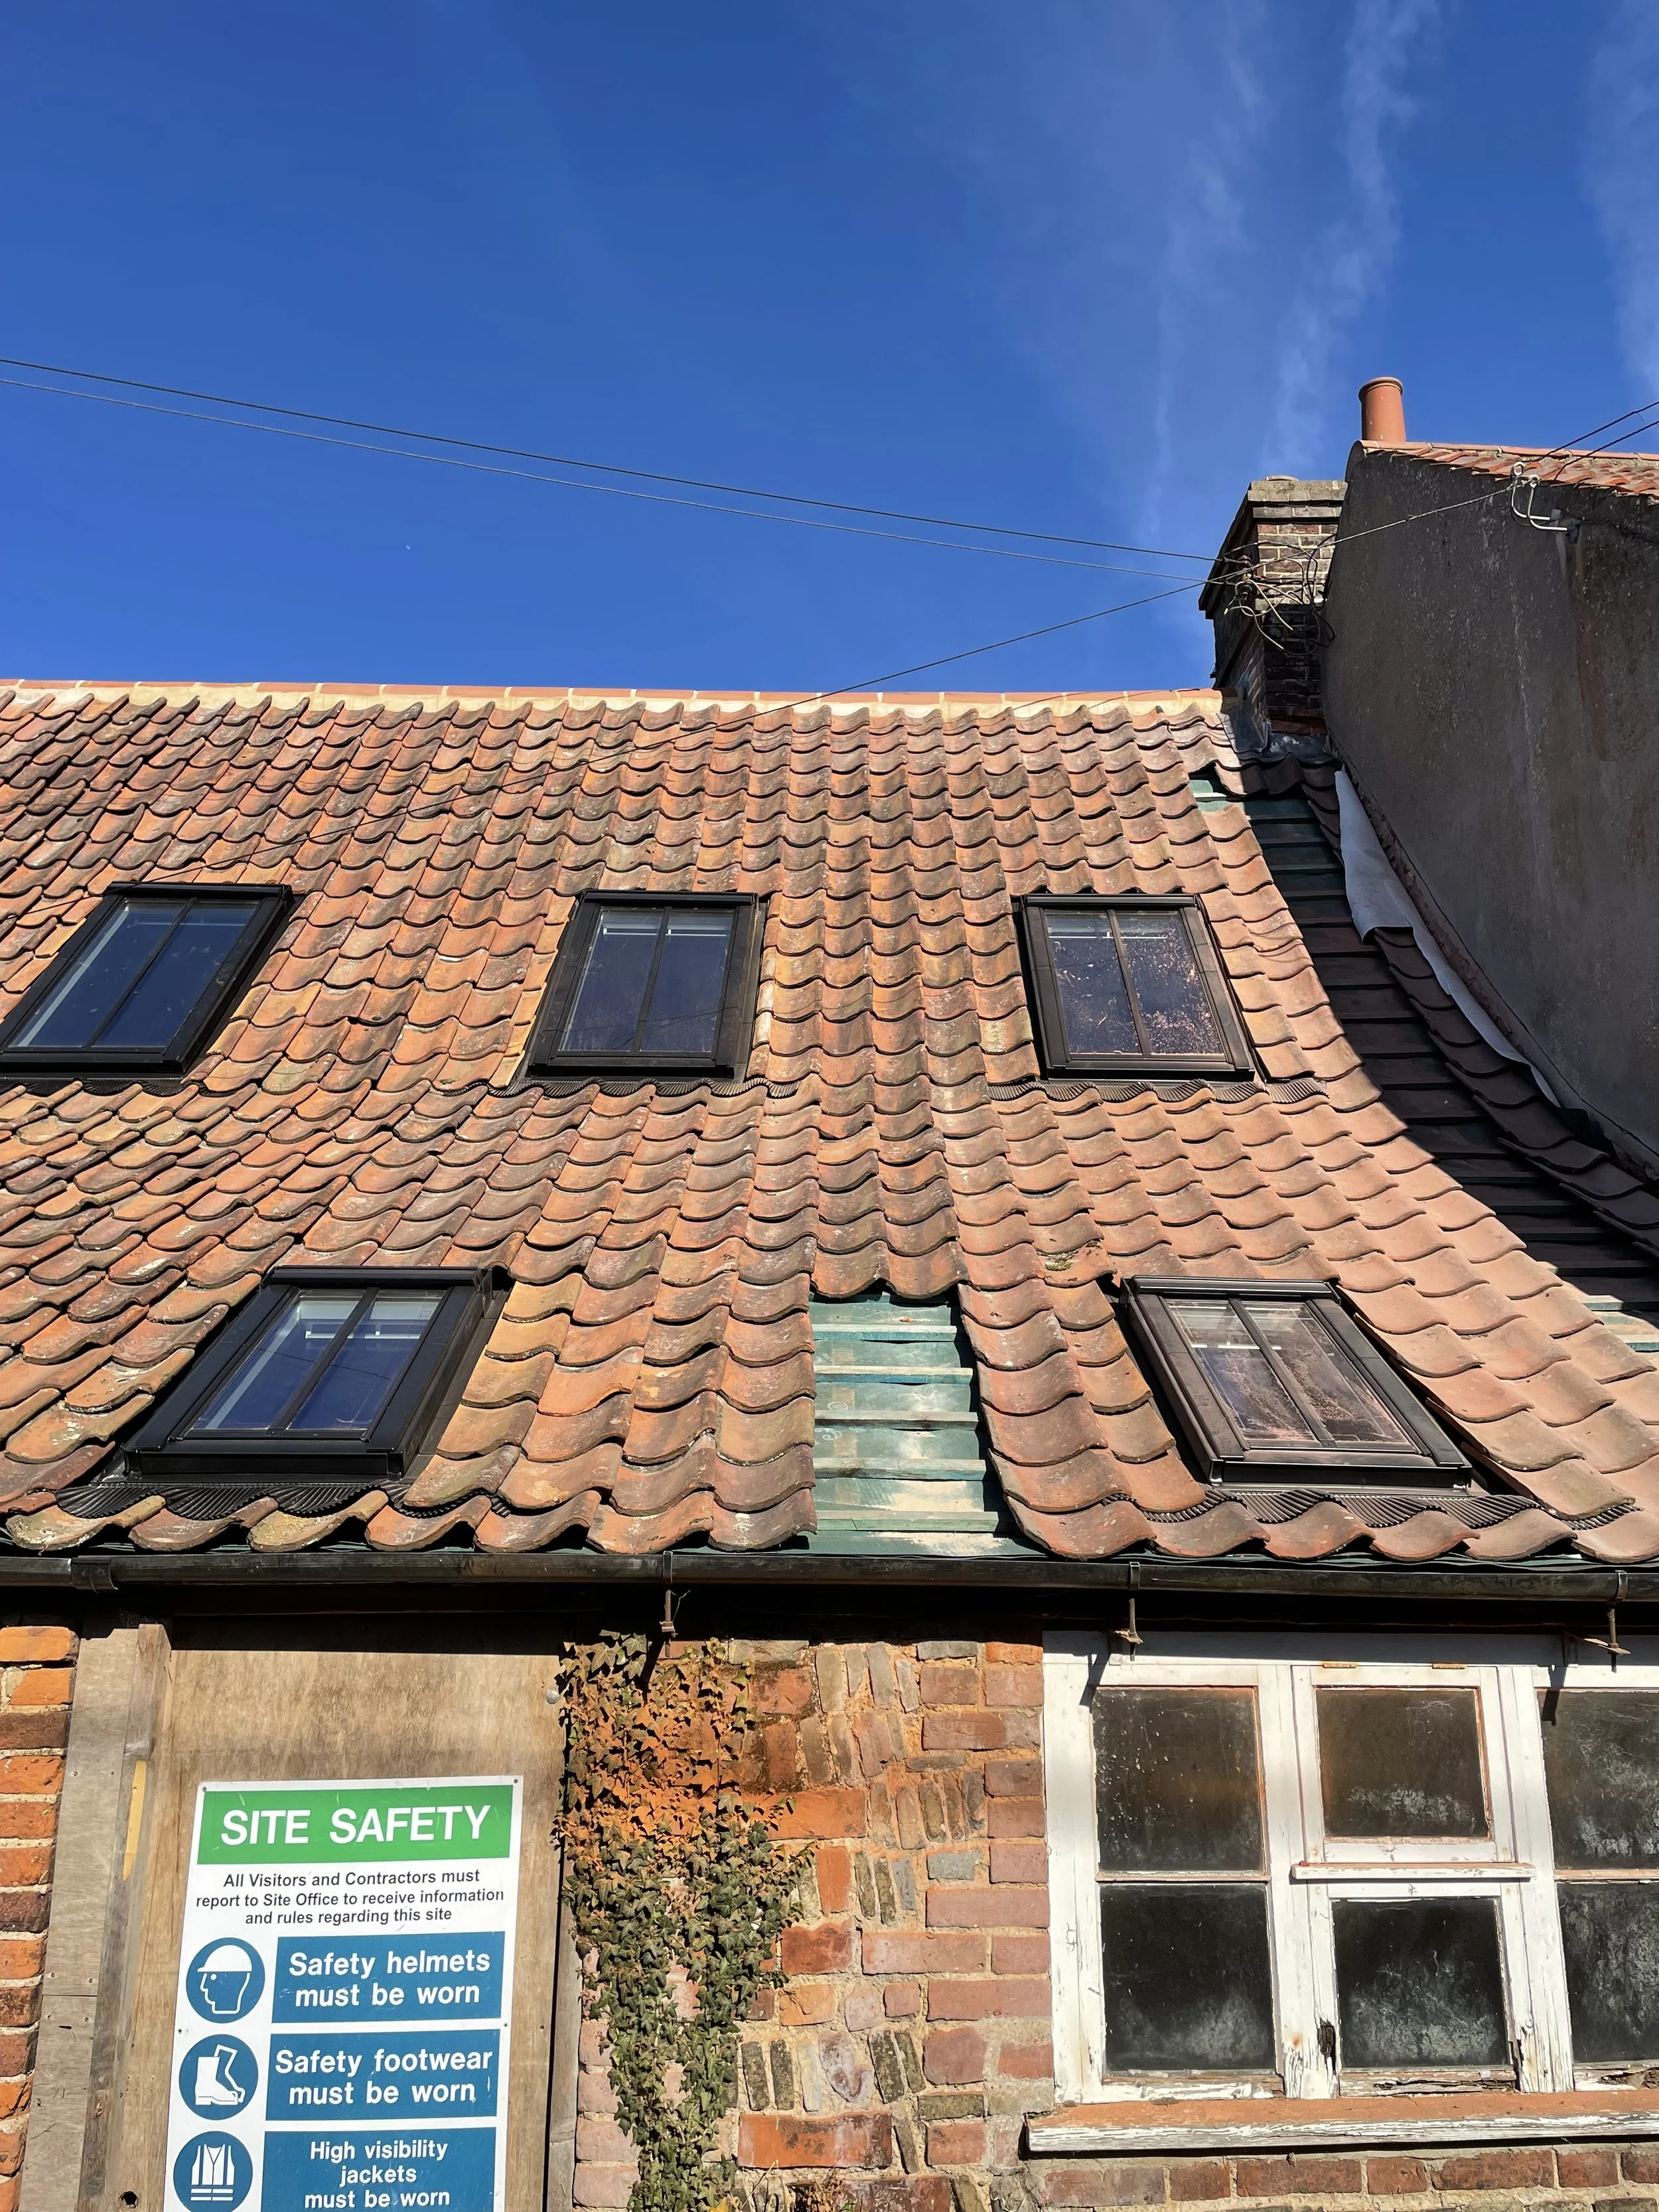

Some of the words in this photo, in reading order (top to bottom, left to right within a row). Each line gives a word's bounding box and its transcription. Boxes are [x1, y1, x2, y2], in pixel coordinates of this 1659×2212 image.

[221, 1809, 311, 1846] SITE
[329, 1805, 491, 1844] SAFETY
[223, 1874, 244, 1887] All
[249, 1874, 307, 1887] Visitors
[312, 1872, 340, 1886] and
[345, 1872, 436, 1885] Contractors
[442, 1869, 480, 1883] must
[196, 1895, 240, 1910] report
[244, 1895, 259, 1907] to
[263, 1893, 291, 1906] Site
[296, 1893, 338, 1906] Office
[343, 1893, 358, 1905] to
[362, 1893, 415, 1905] receive
[420, 1889, 504, 1903] information
[246, 1911, 273, 1924] and
[277, 1911, 313, 1924] rules
[318, 1909, 389, 1926] regarding
[394, 1909, 421, 1921] this
[425, 1908, 452, 1921] site
[289, 1952, 376, 1979] Safety
[387, 1949, 490, 1974] helmets
[295, 1984, 360, 2007] must
[372, 1982, 405, 2006] be
[417, 1985, 480, 2004] worn
[275, 2049, 362, 2077] Safety
[374, 2049, 493, 2072] footwear
[289, 2082, 354, 2104] must
[366, 2081, 399, 2104] be
[411, 2083, 476, 2102] worn
[311, 2141, 355, 2164] High
[364, 2139, 448, 2161] visibility
[339, 2165, 417, 2187] jackets
[305, 2190, 356, 2209] must
[364, 2189, 391, 2208] be
[399, 2191, 450, 2207] worn
